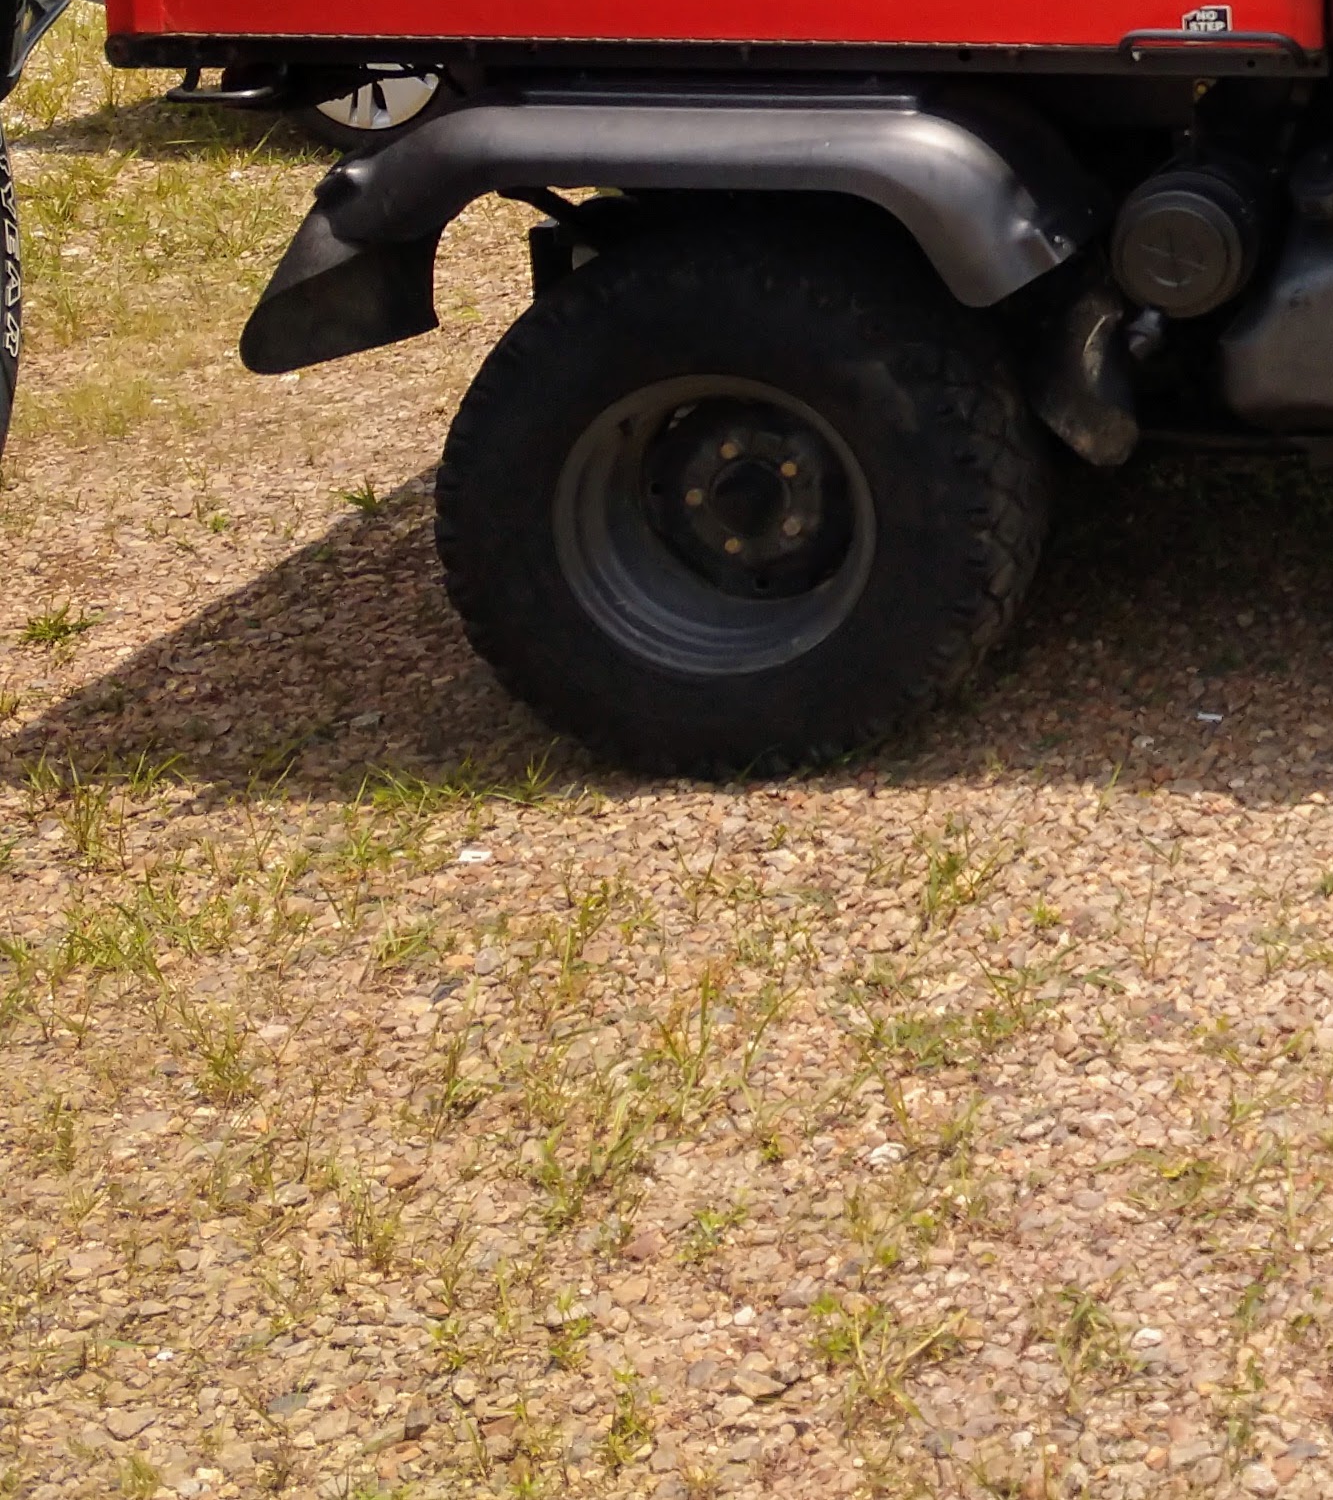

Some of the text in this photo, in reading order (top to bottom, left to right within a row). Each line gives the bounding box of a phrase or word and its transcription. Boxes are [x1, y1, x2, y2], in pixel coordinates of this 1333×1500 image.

[1196, 10, 1218, 21] NO
[1189, 21, 1226, 32] STEP
[0, 155, 21, 358] YEAR
